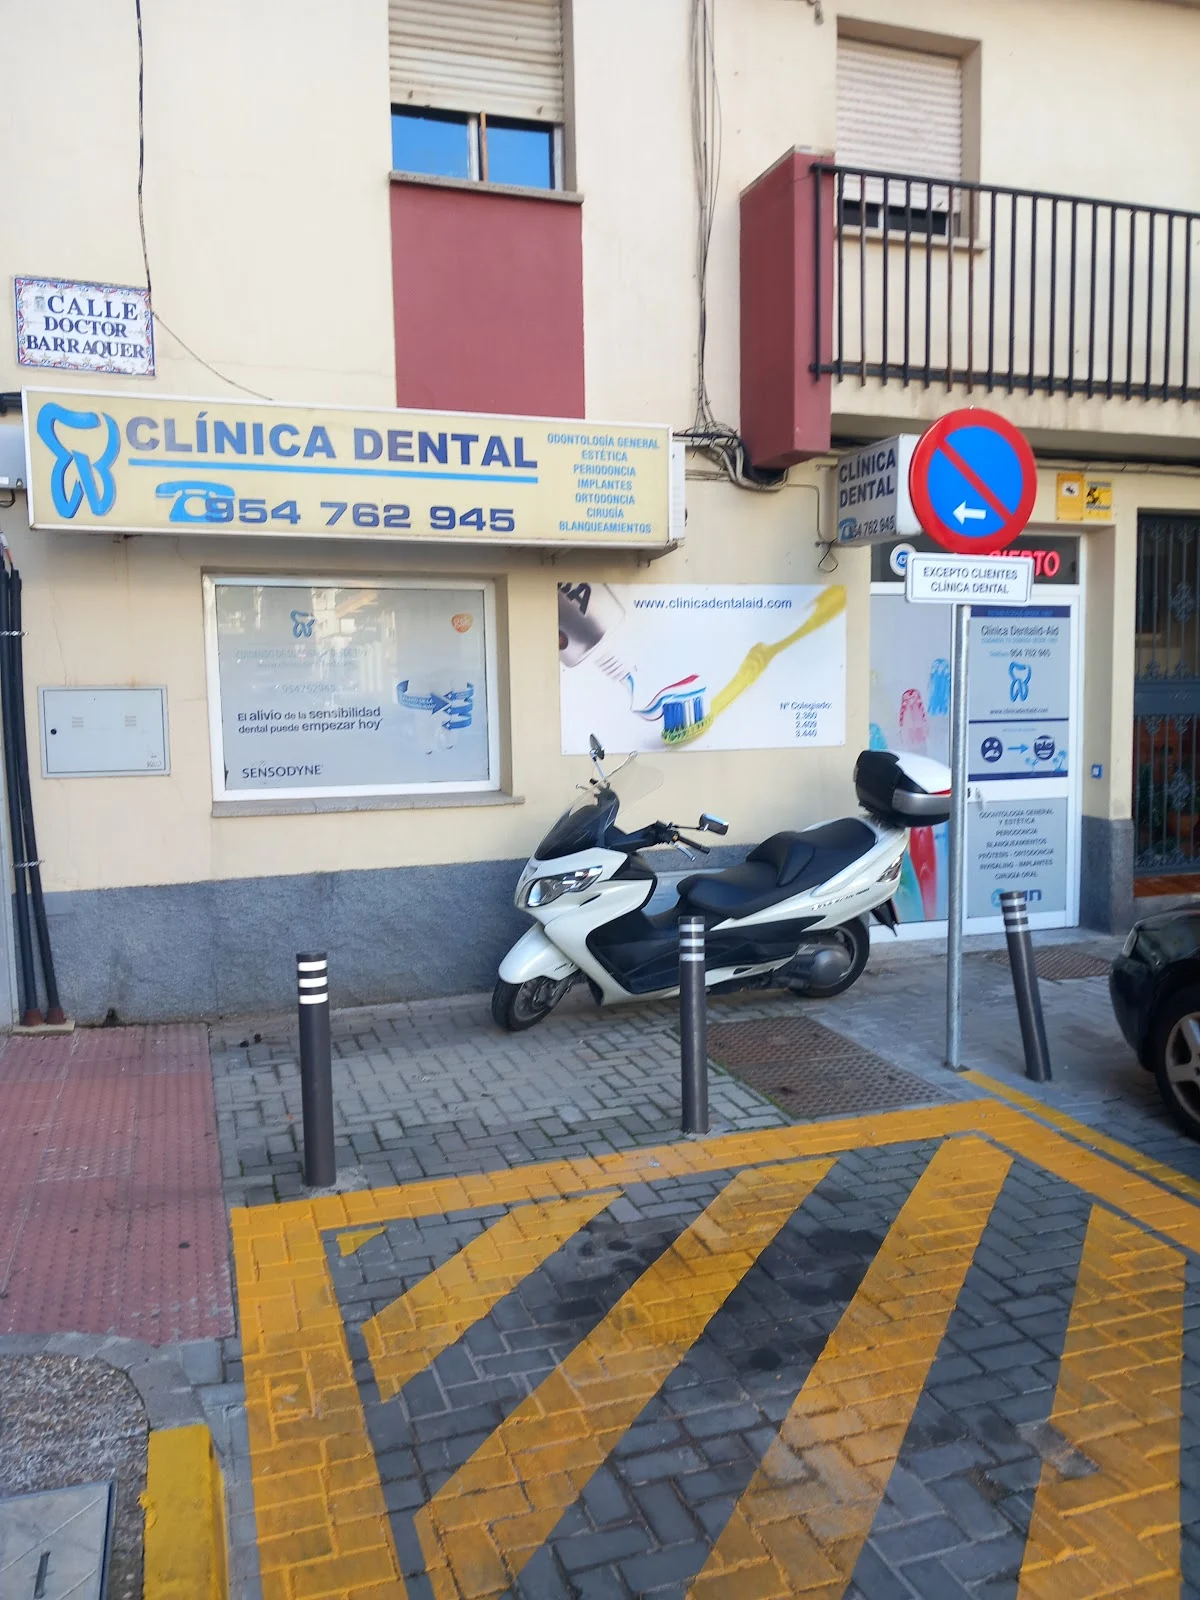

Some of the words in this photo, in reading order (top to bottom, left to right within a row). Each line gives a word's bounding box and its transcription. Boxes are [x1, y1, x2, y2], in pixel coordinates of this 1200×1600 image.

[47, 295, 138, 321] CALLE
[43, 315, 128, 338] DOCTOR
[26, 334, 146, 359] BARRAQUER
[125, 411, 337, 459] CLÍNICA
[353, 427, 538, 469] DENTAL
[547, 432, 615, 447] ODONTOLOGÍA
[617, 436, 660, 449] GENERAL
[581, 448, 628, 462] ESTÉTICA
[573, 463, 637, 477] PERIODONCIA
[840, 447, 896, 483] CLÍNICA
[577, 478, 633, 491] IMPLANTES
[840, 474, 895, 508] DENTAL
[575, 492, 635, 505] ORTODONCIA
[204, 497, 301, 525] 954
[320, 501, 411, 528] 762
[429, 506, 515, 532] 945
[586, 506, 625, 519] CIRUGÍA
[559, 520, 652, 534] BLANQUEAMIENTOS
[923, 566, 969, 579] EXCEPTO
[971, 568, 1018, 580] CLIENTES
[930, 580, 970, 593] CLÍNICA
[972, 583, 1009, 594] DENTAL
[633, 596, 792, 609] www.clinicadentalaid.com
[237, 712, 247, 722] El
[249, 709, 282, 721] alivio
[284, 711, 296, 720] de
[298, 711, 307, 720] la
[308, 706, 381, 720] sensibilidad
[238, 724, 268, 734] dental
[270, 723, 300, 734] puede
[301, 720, 355, 733] empezar
[358, 718, 382, 731] hoy
[241, 764, 321, 779] SENSODYNE
